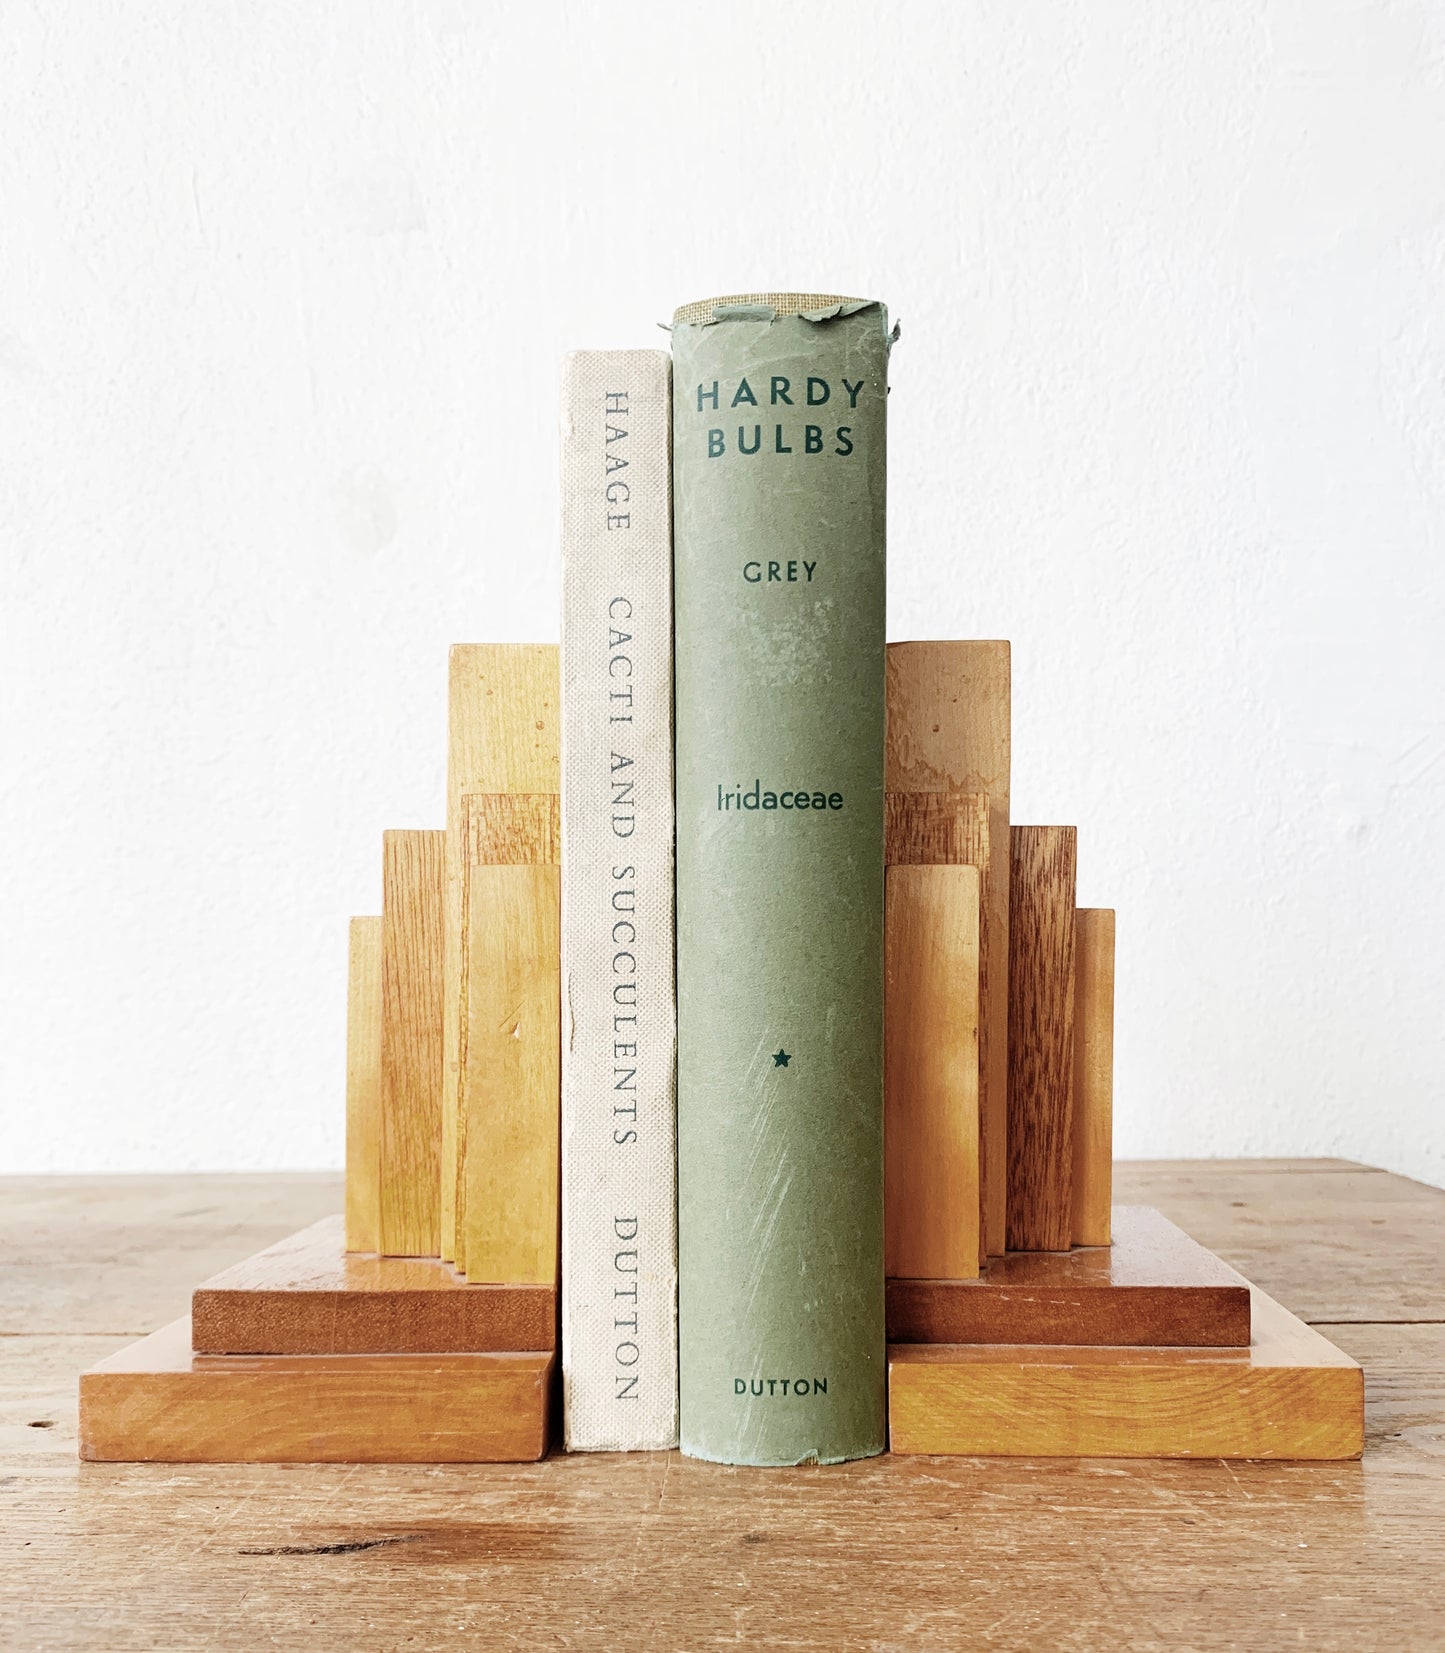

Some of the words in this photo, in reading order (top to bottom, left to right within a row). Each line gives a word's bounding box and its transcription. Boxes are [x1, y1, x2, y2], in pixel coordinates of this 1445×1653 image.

[697, 376, 865, 412] HARDY
[605, 390, 632, 531] HAAGE
[708, 424, 855, 458] BULBS
[743, 561, 818, 583] GREY
[608, 597, 633, 725] CACTI
[610, 752, 636, 838] AND
[717, 779, 844, 811] Iridaceae
[612, 866, 638, 1145] SUCCULENTS
[613, 1216, 640, 1402] DUTTON
[734, 1376, 829, 1397] DUTTON
